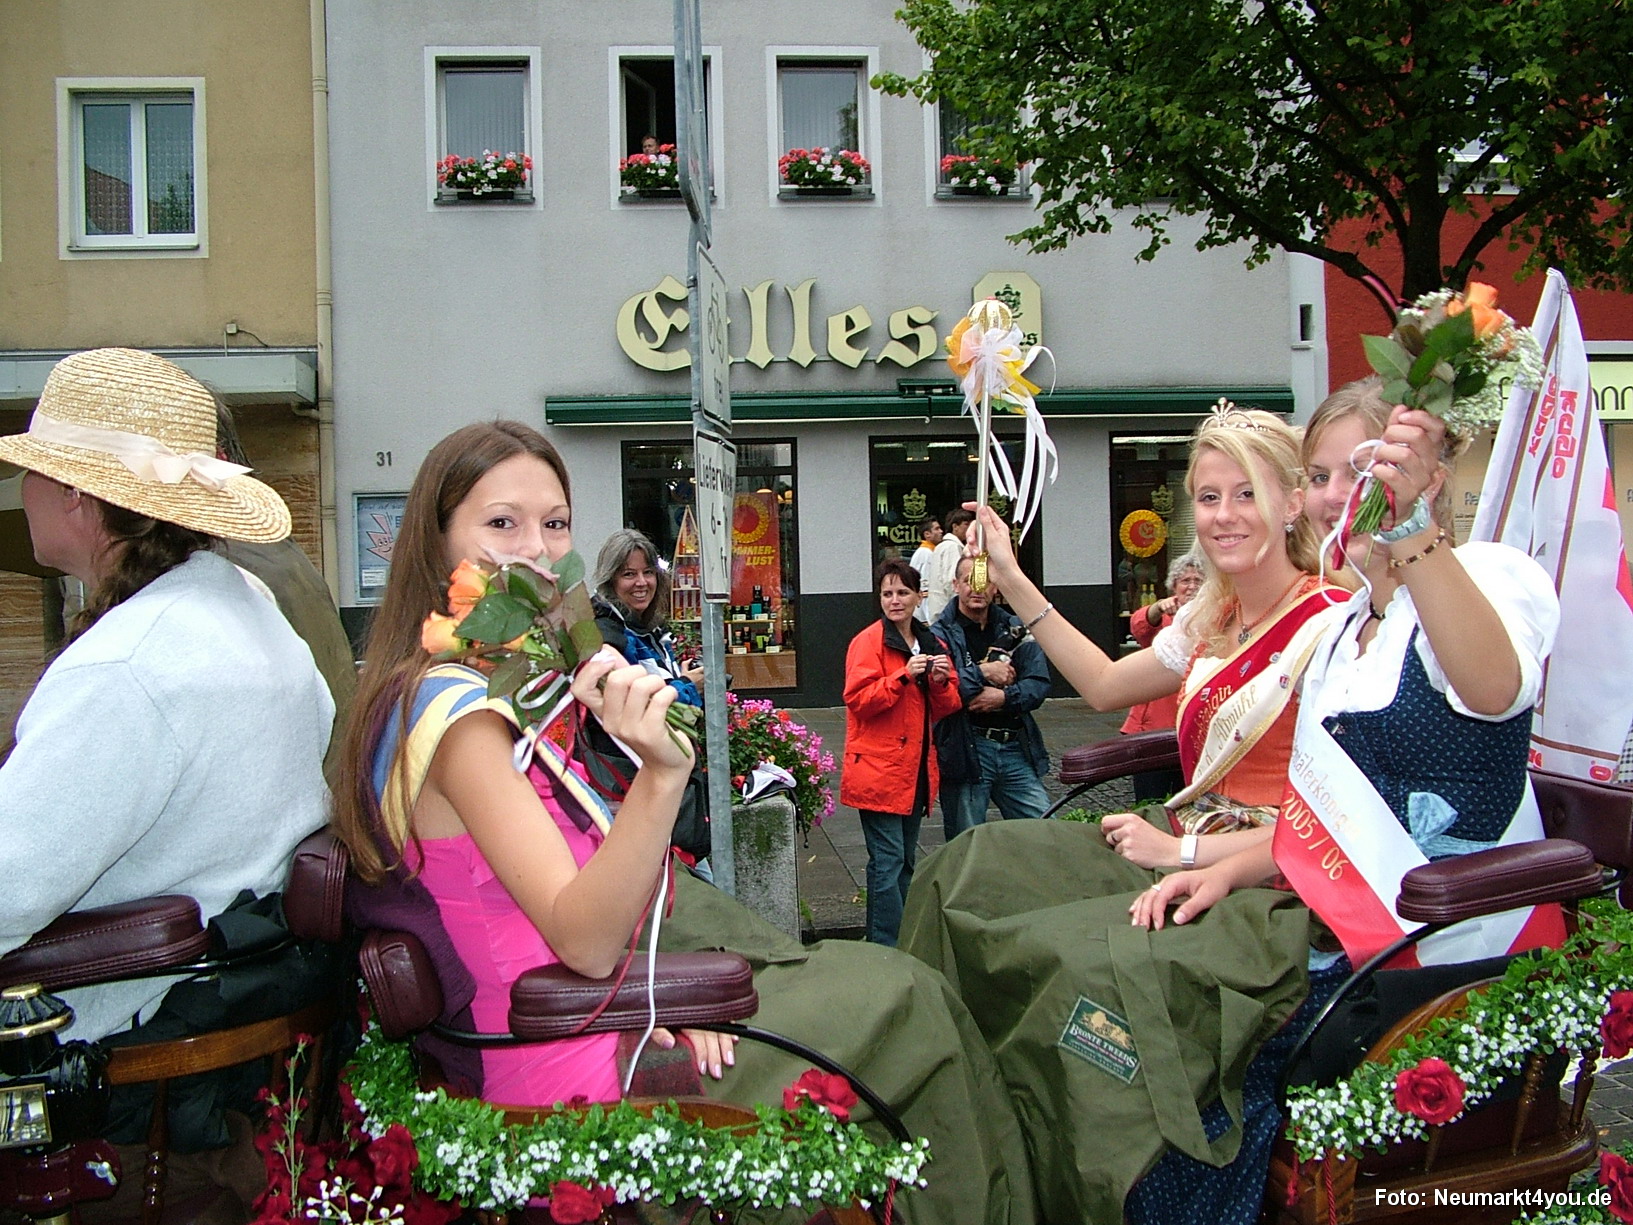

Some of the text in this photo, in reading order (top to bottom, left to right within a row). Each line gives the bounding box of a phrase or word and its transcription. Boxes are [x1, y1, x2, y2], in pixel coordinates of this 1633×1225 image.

[616, 275, 939, 370] Elles
[376, 451, 392, 467] 31
[746, 556, 774, 566] LUST
[1321, 848, 1351, 881] 06
